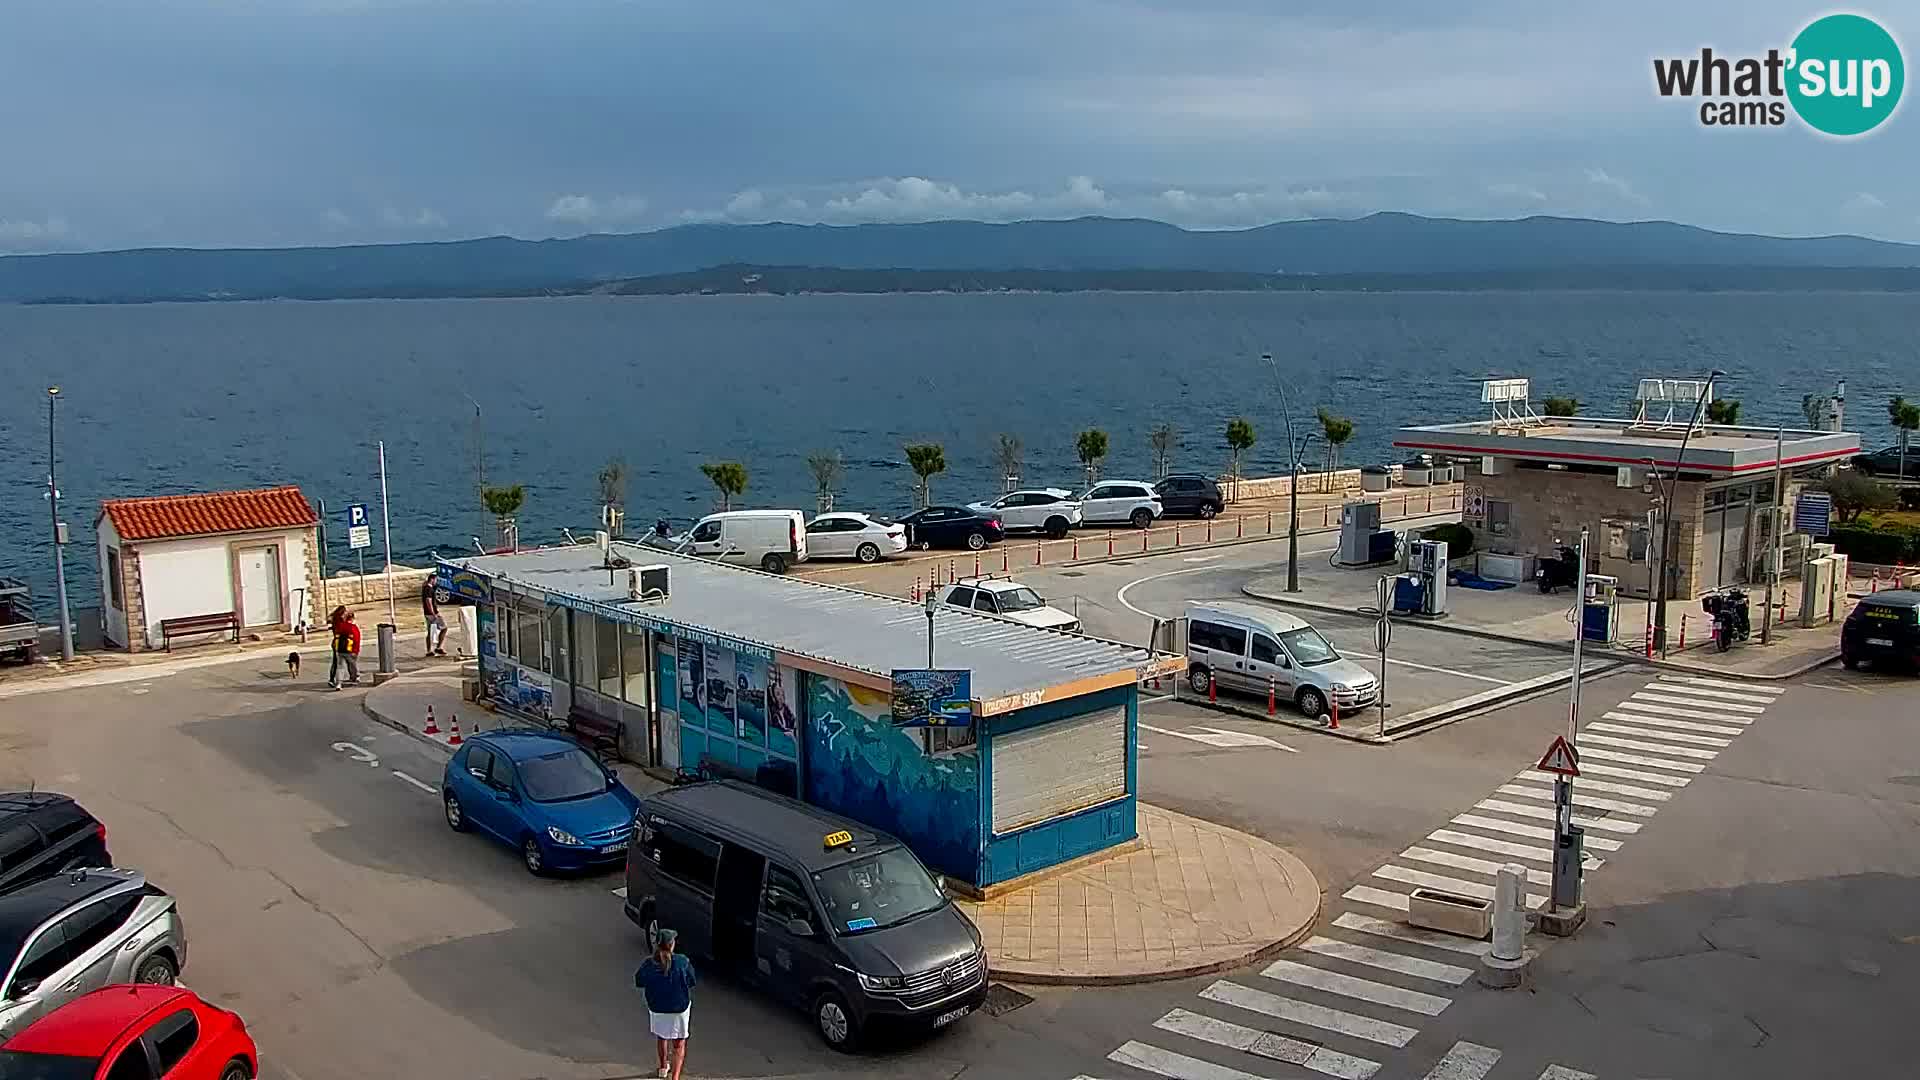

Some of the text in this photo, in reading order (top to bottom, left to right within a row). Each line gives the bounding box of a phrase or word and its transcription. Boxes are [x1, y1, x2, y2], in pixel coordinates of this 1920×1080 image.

[351, 507, 363, 525] P
[687, 630, 717, 644] STATION
[719, 637, 744, 653] TICKET
[745, 645, 771, 659] OFFICE
[829, 831, 849, 844] TAXI
